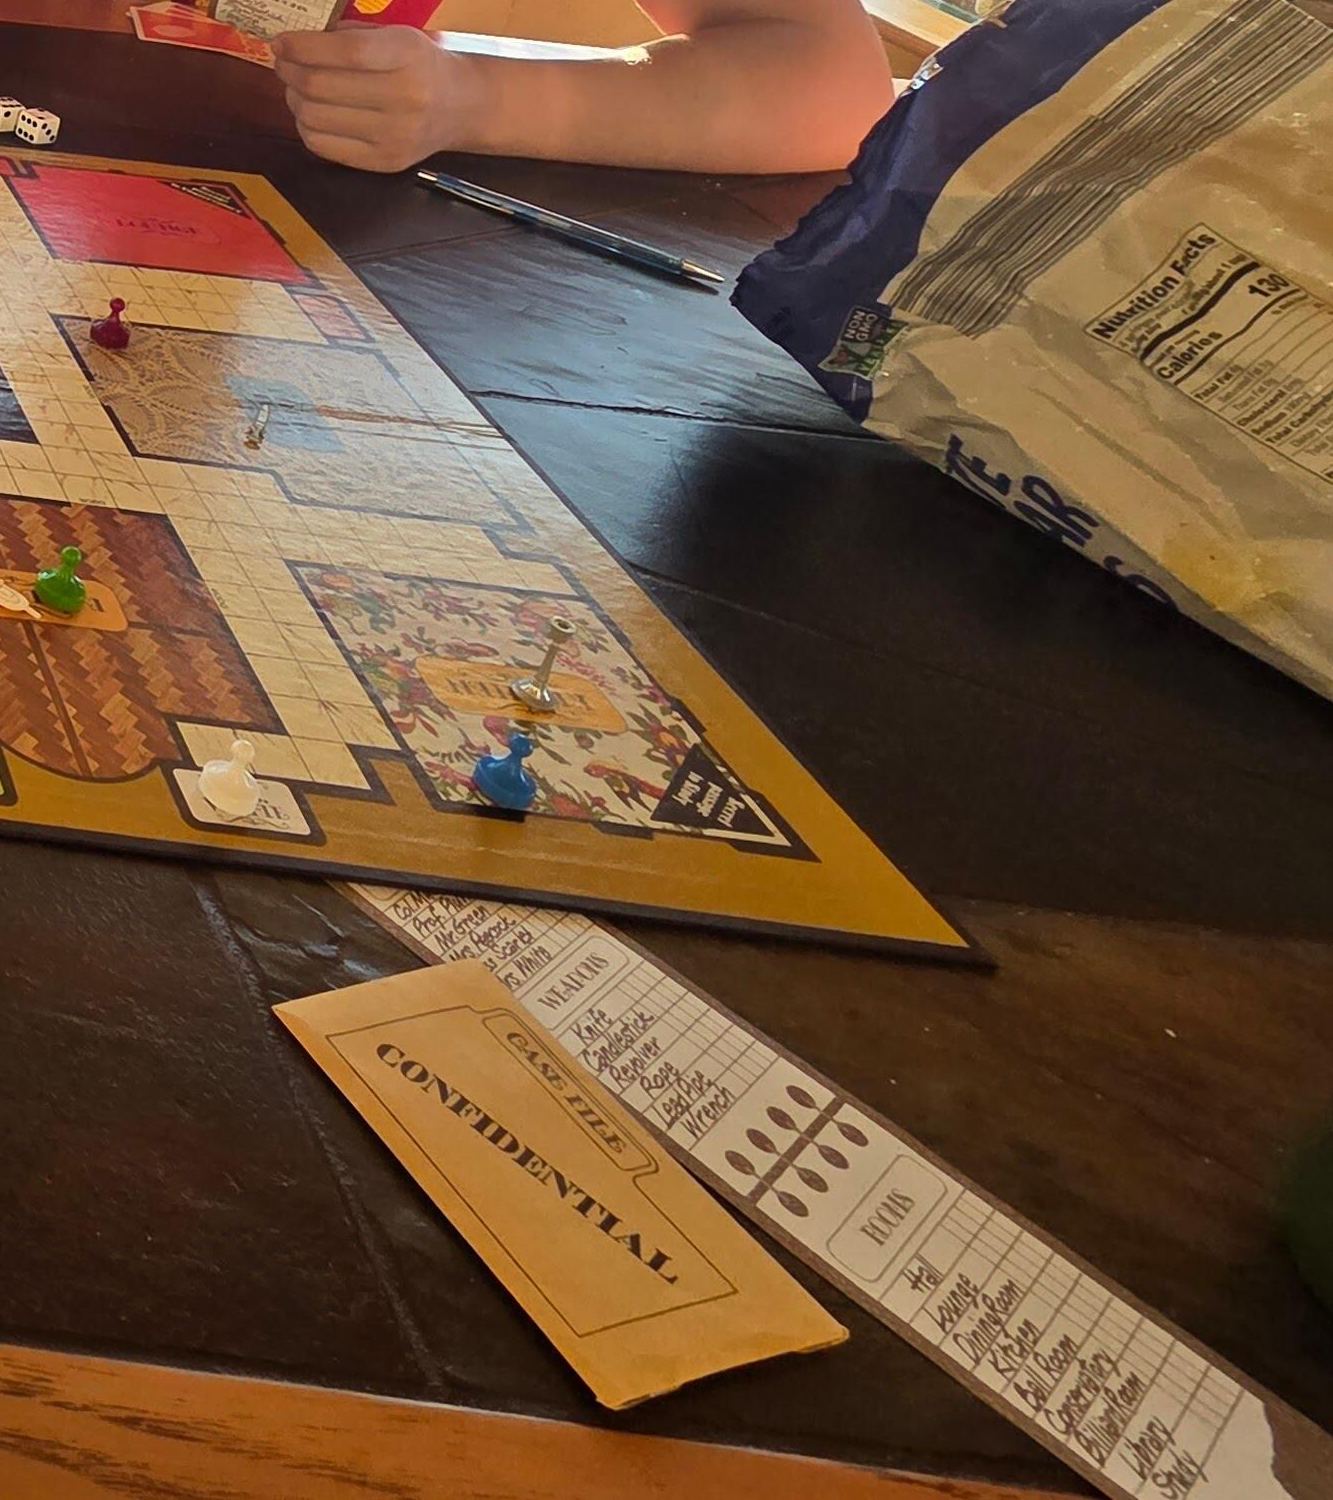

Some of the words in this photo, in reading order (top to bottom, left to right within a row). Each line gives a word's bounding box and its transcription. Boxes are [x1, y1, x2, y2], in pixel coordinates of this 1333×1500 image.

[844, 310, 866, 339] NON
[856, 313, 879, 342] GMO
[1092, 274, 1180, 339] Nutrition
[1156, 330, 1224, 380] Calories
[1247, 272, 1290, 299] 130
[452, 904, 491, 934] Green
[536, 951, 610, 1011] WEAPONS
[571, 1008, 614, 1046] Knife
[583, 1010, 655, 1073] Candlestick
[609, 1035, 662, 1091] Revolver
[639, 1060, 679, 1101] Rope
[506, 1031, 567, 1091] CASE
[563, 1094, 627, 1154] FILE
[679, 1084, 735, 1141] Wrench
[377, 1042, 679, 1285] CONFIDENTIAL
[860, 1188, 915, 1247] ROOMS
[901, 1252, 944, 1293] Hall
[922, 1273, 981, 1334] Lounge
[987, 1318, 1042, 1381] Kitchen
[1033, 1334, 1081, 1383] Room
[1118, 1416, 1176, 1481] Library
[1152, 1449, 1209, 1500] Study
